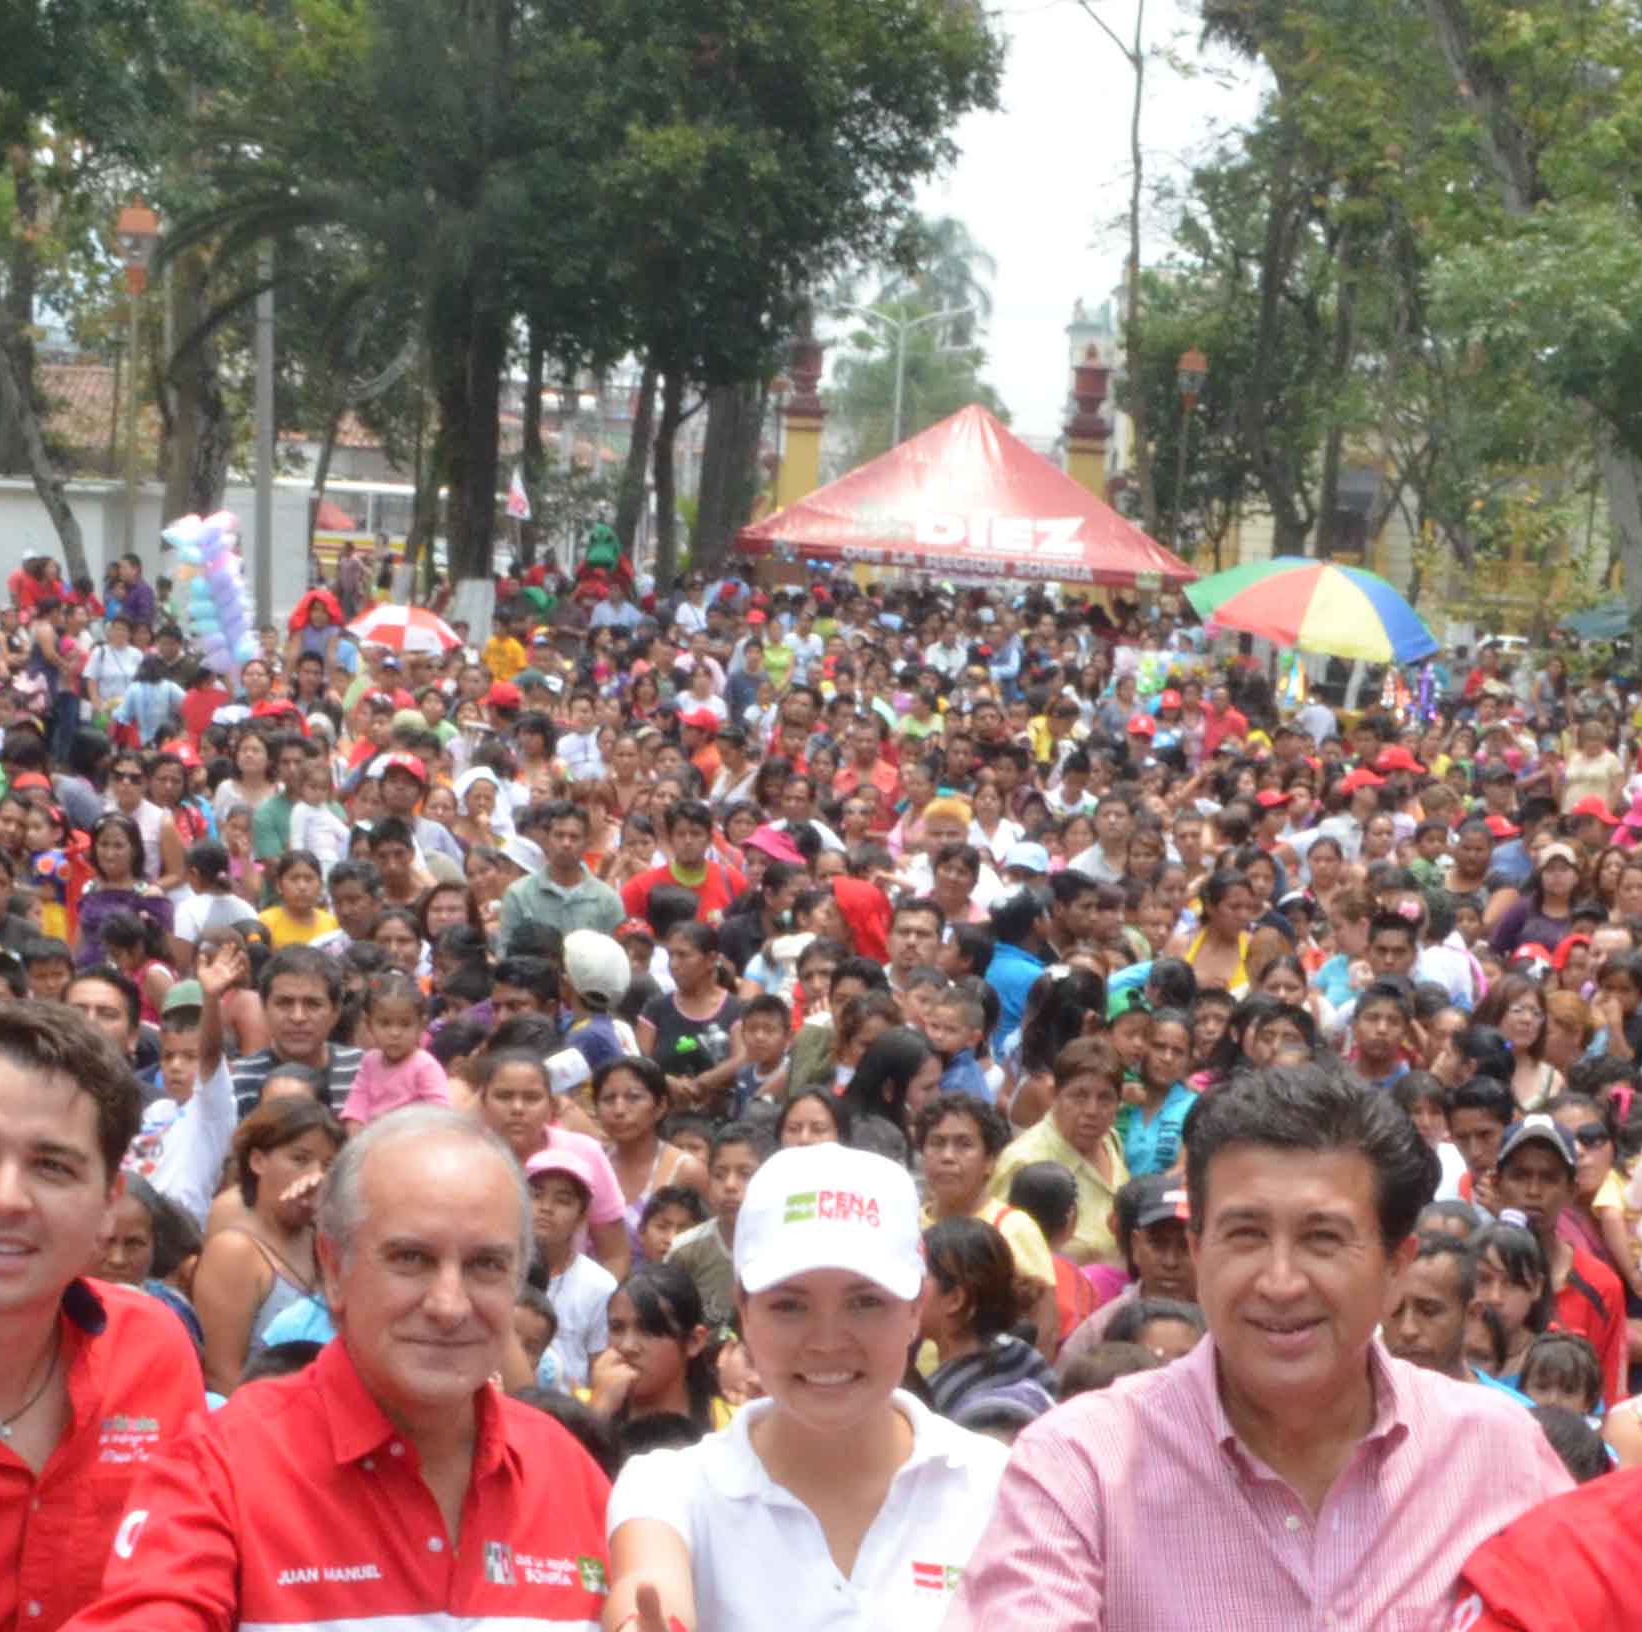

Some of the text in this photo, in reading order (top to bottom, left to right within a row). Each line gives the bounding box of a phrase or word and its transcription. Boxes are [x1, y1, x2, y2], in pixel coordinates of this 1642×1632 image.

[917, 511, 1085, 556] DIEZ
[277, 1563, 383, 1586] JUAN MANUEL
